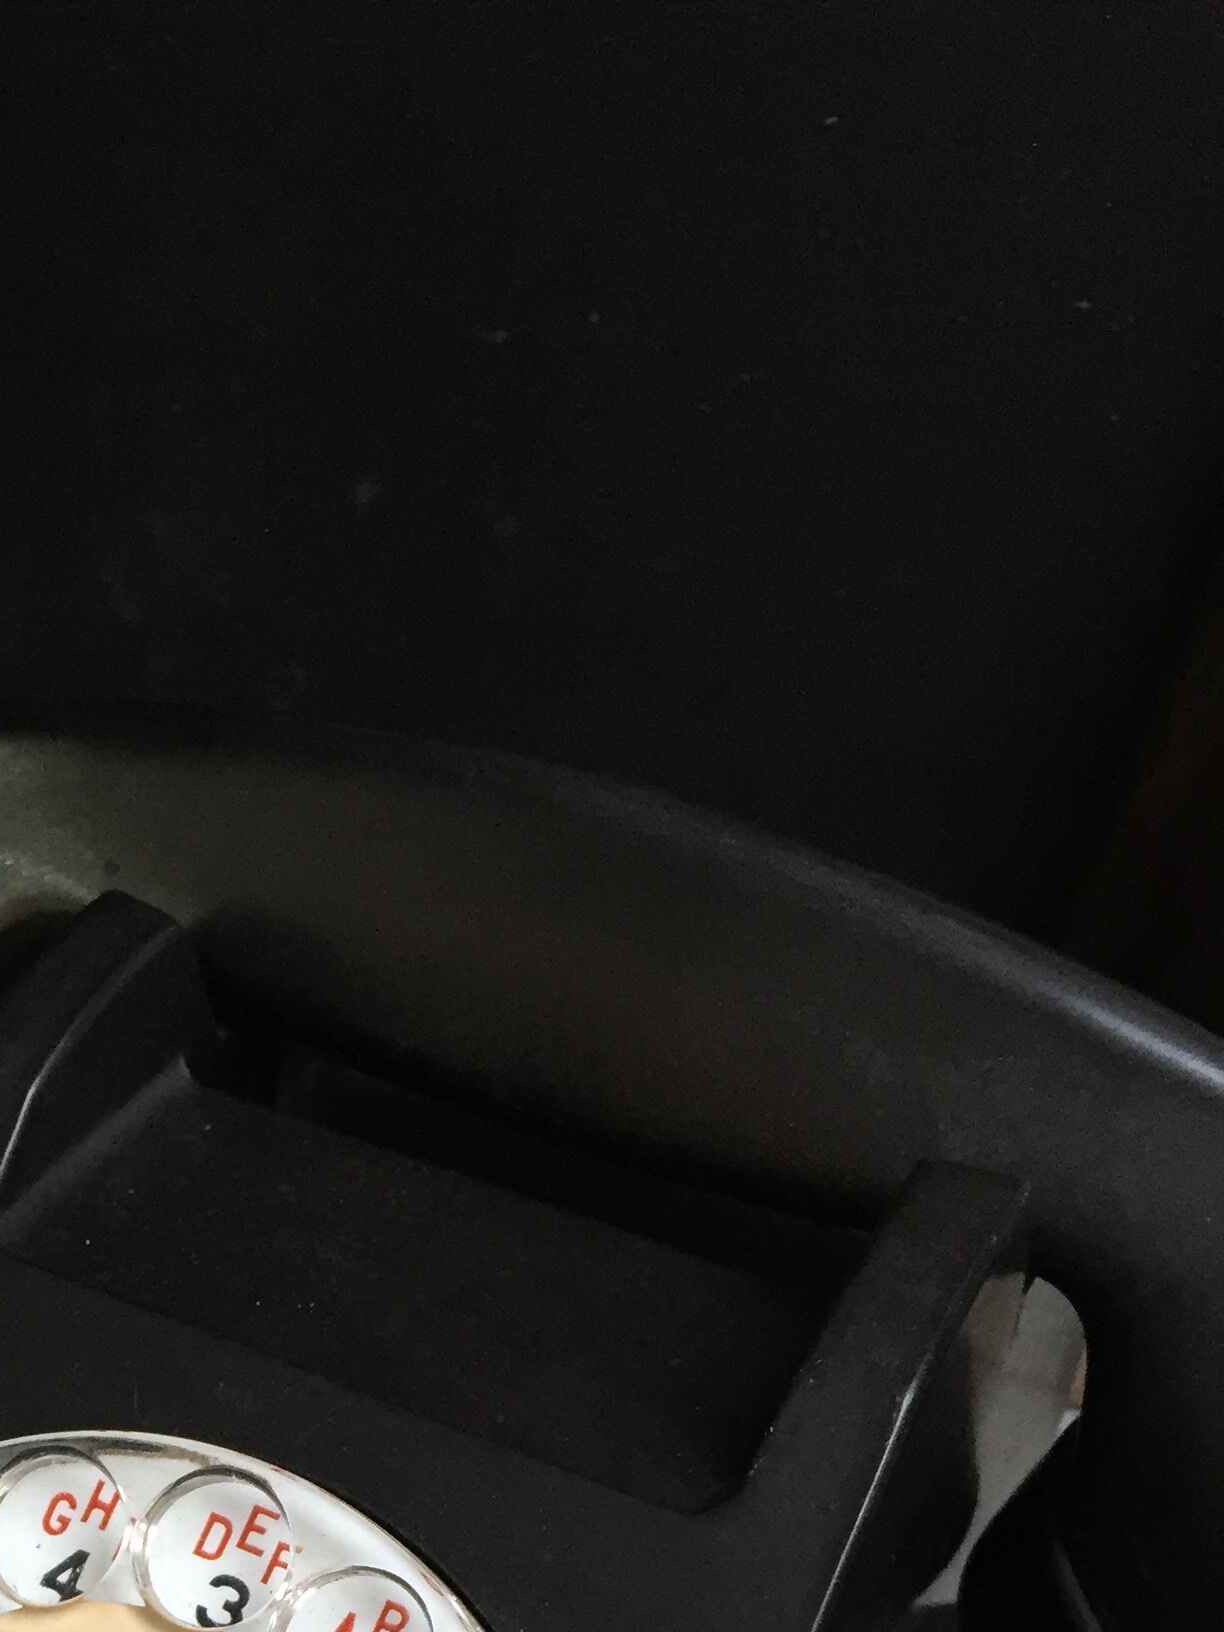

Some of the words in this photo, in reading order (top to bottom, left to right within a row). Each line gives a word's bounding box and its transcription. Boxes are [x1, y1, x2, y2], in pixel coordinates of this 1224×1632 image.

[41, 1479, 123, 1562] GH
[192, 1504, 294, 1585] DEF
[40, 1549, 91, 1603] 4
[196, 1574, 251, 1629] 3
